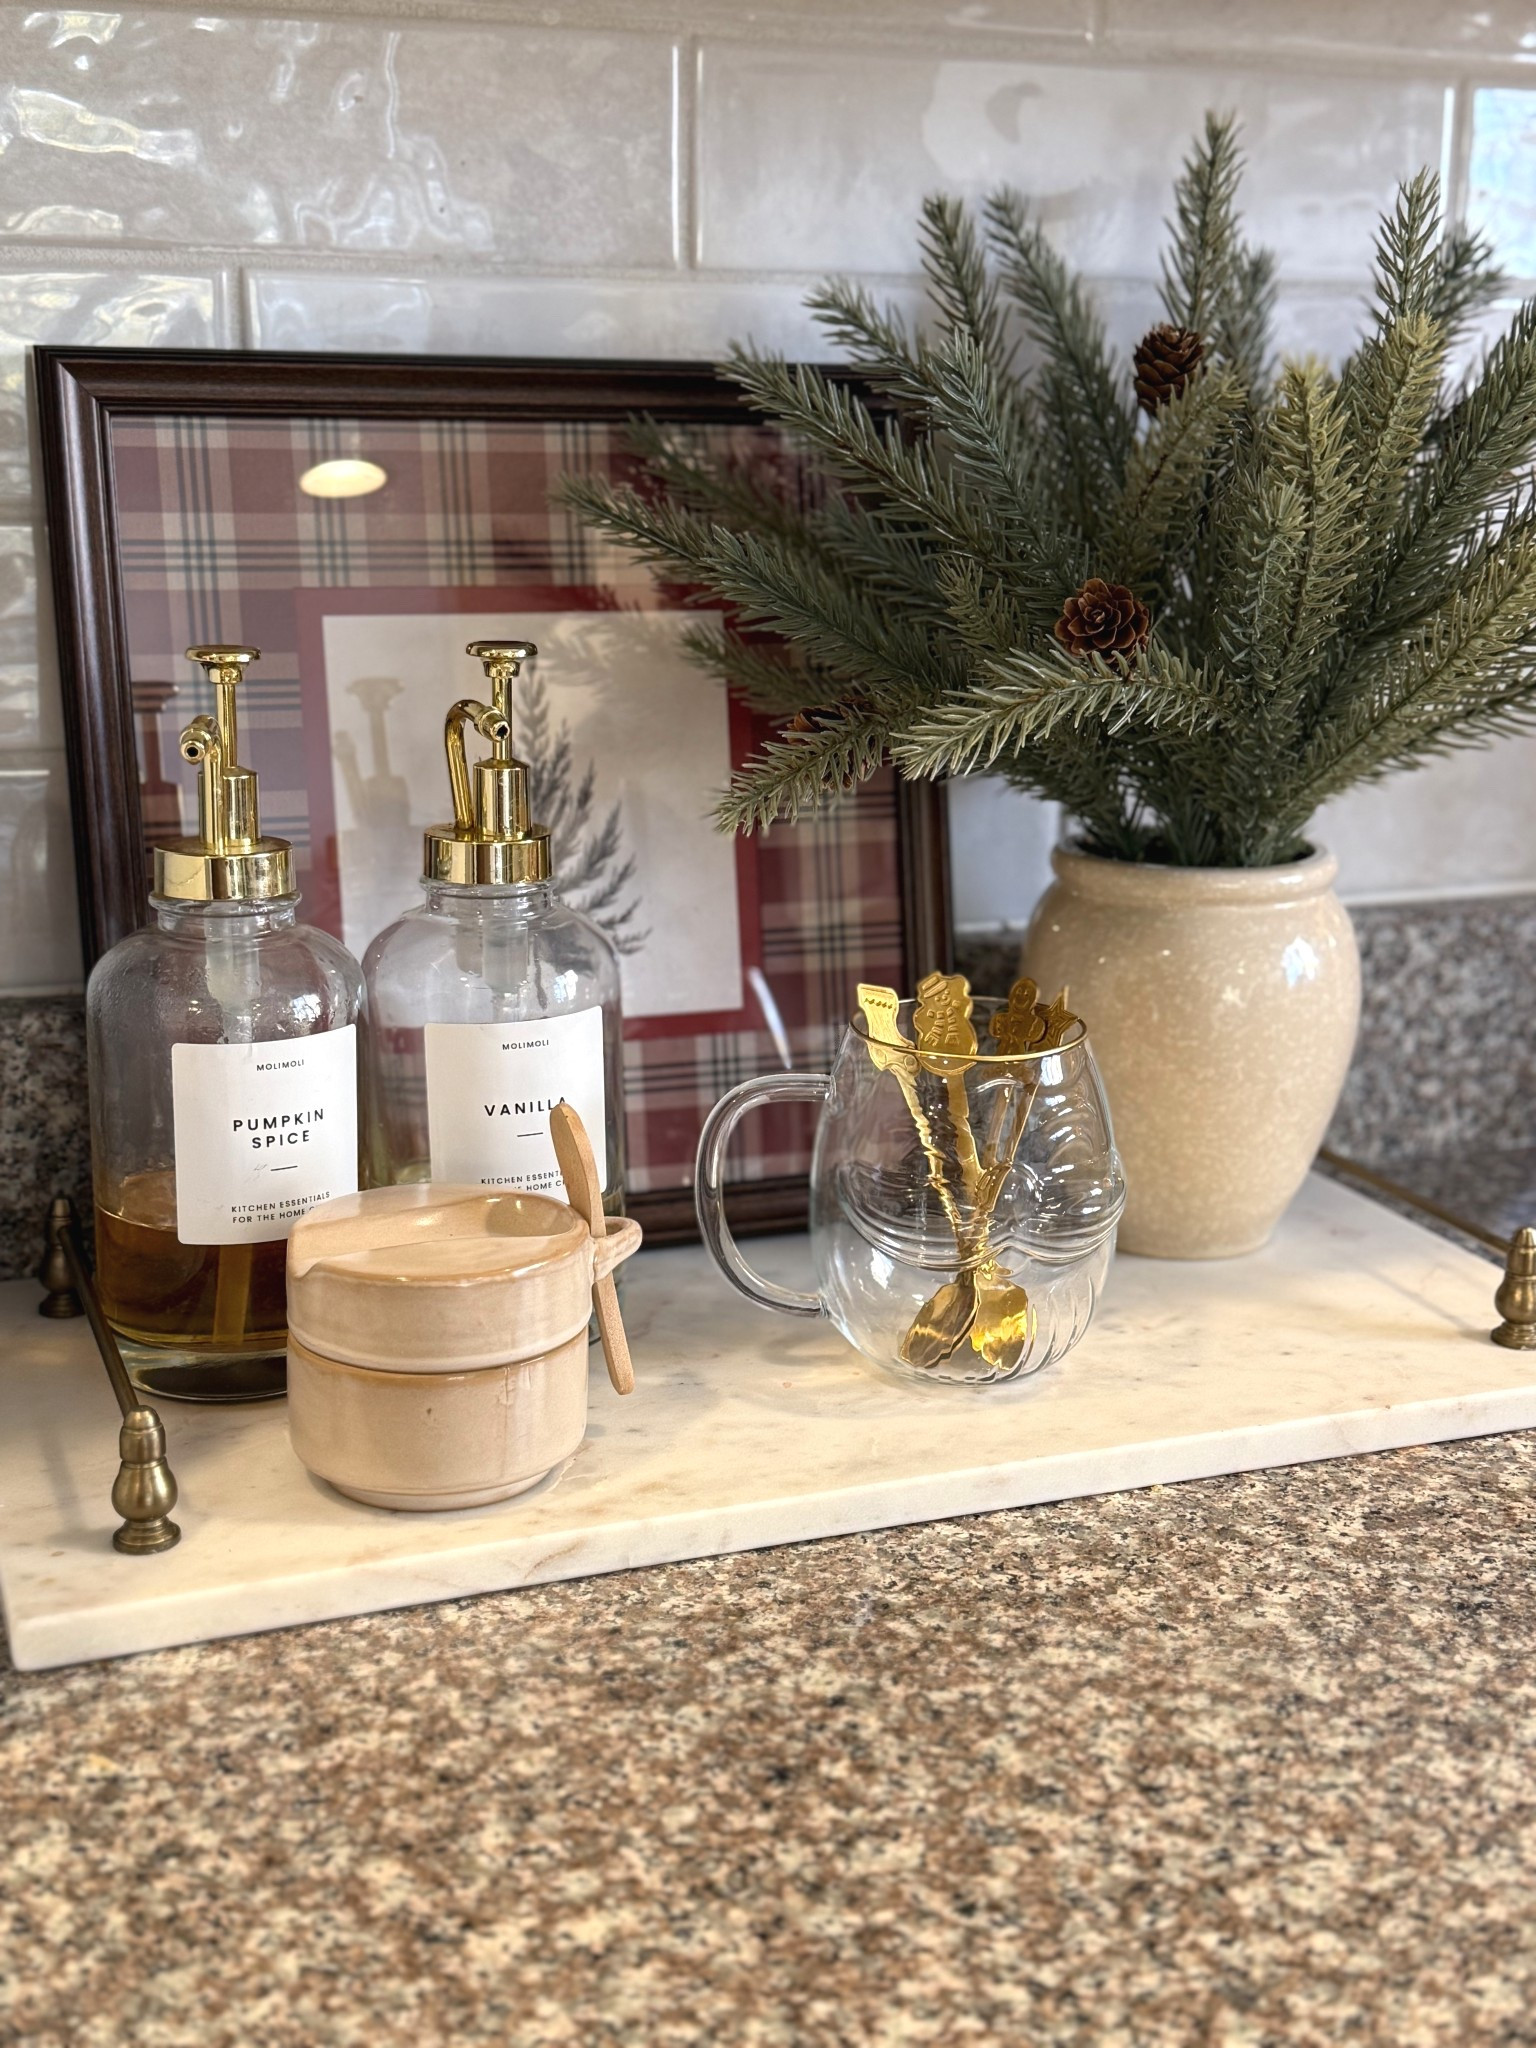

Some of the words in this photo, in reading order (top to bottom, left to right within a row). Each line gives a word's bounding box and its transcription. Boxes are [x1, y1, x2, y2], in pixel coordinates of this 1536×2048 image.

[502, 1039, 550, 1051] MOLIMOLI
[256, 1059, 305, 1072] MOLIMOLI
[233, 1108, 325, 1132] PUMPKIN
[251, 1130, 311, 1149] SPICE
[480, 1176, 523, 1185] KITCHEN
[526, 1170, 560, 1182] ESSENT
[526, 1181, 552, 1191] HOME
[231, 1202, 276, 1213] KITCHEN
[279, 1191, 330, 1209] ESSENTIALS
[232, 1216, 253, 1224] FOR
[257, 1213, 275, 1222] THE
[279, 1208, 306, 1220] HOME
